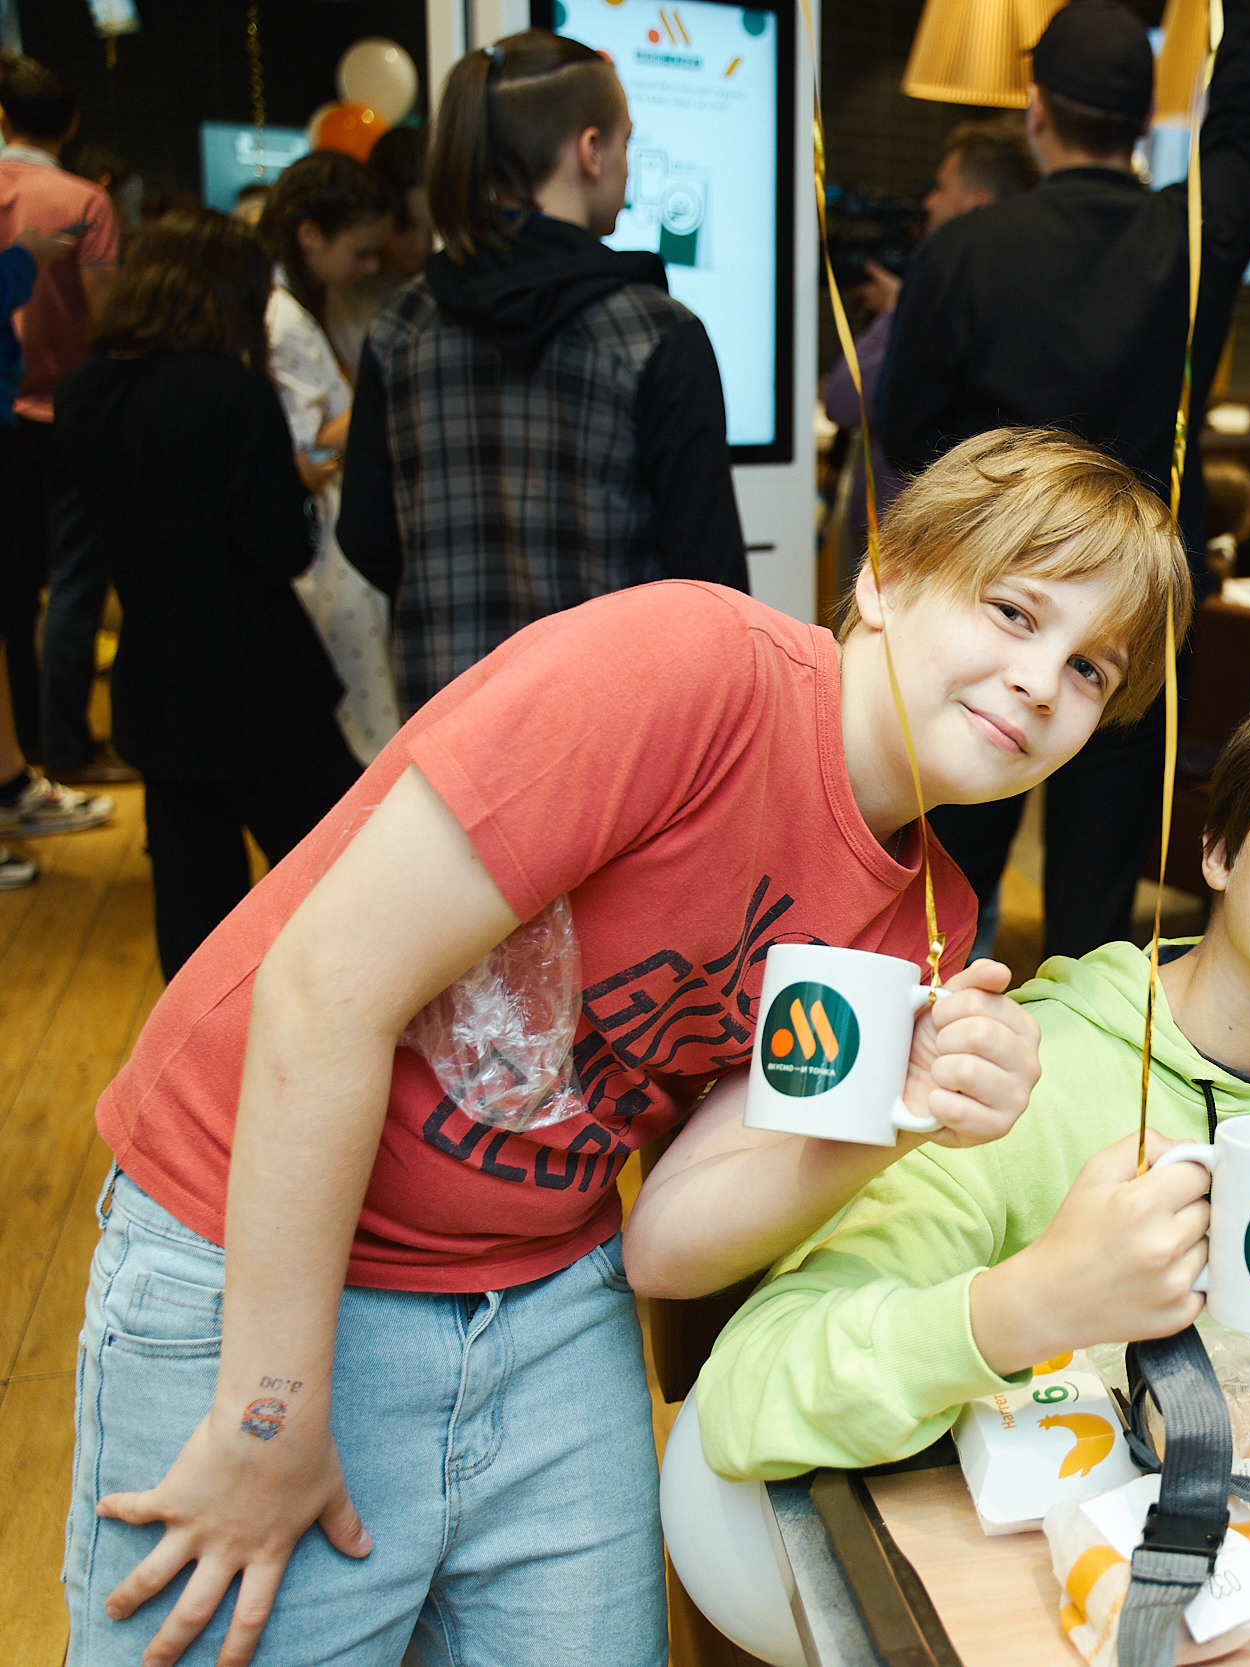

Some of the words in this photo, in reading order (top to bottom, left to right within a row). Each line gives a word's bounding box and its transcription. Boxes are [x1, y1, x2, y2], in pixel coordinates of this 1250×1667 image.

[768, 1062, 794, 1072] ВКУСНО
[808, 1066, 836, 1077] ТОЧКА
[1032, 1385, 1069, 1404] 6
